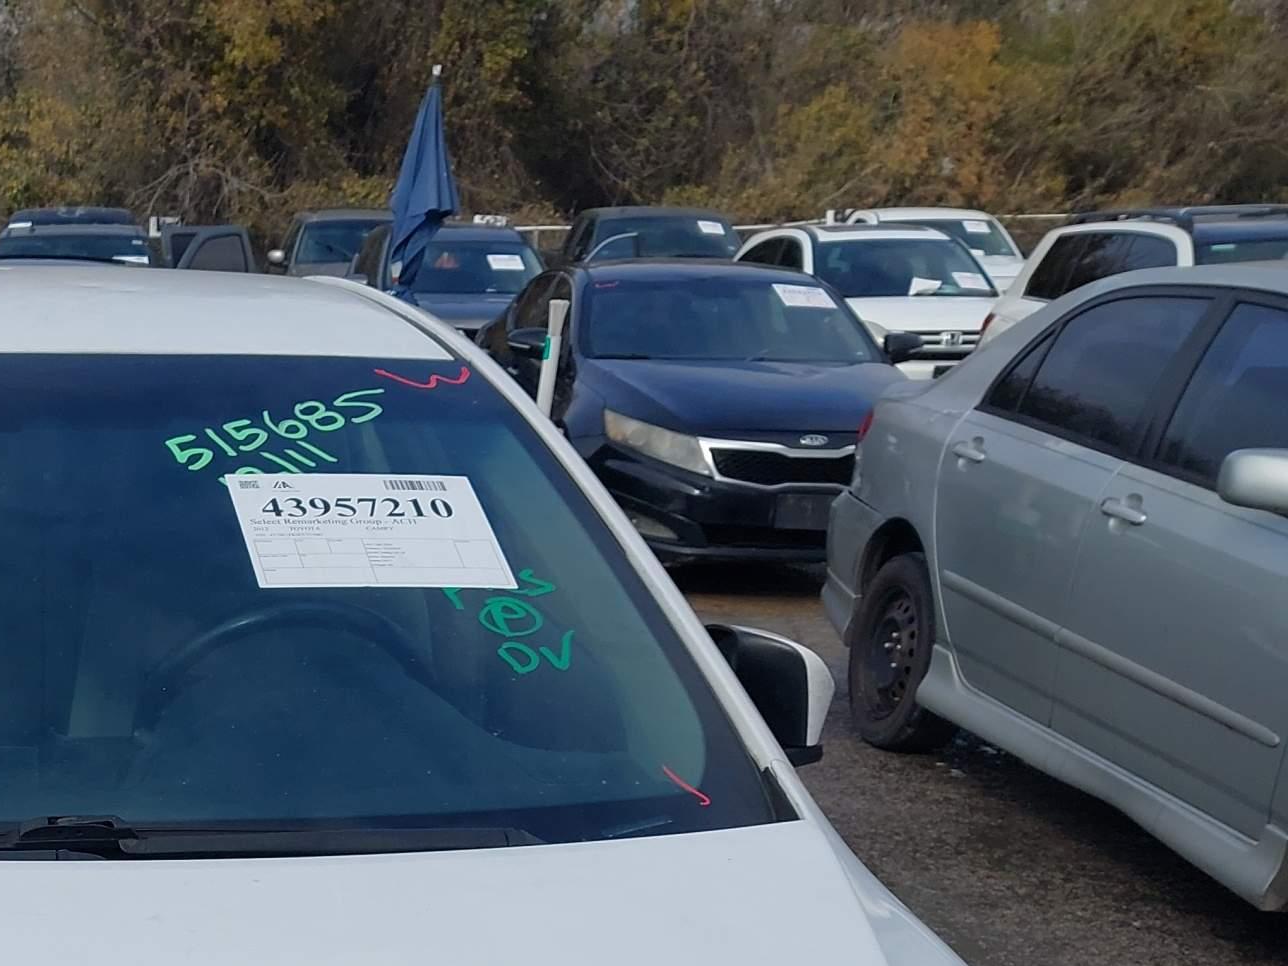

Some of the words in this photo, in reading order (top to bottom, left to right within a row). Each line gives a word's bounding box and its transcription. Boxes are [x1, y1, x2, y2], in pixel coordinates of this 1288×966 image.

[262, 497, 454, 518] 43957210
[250, 518, 280, 526] Select
[283, 518, 348, 527] Remarketing
[349, 518, 383, 527] Group
